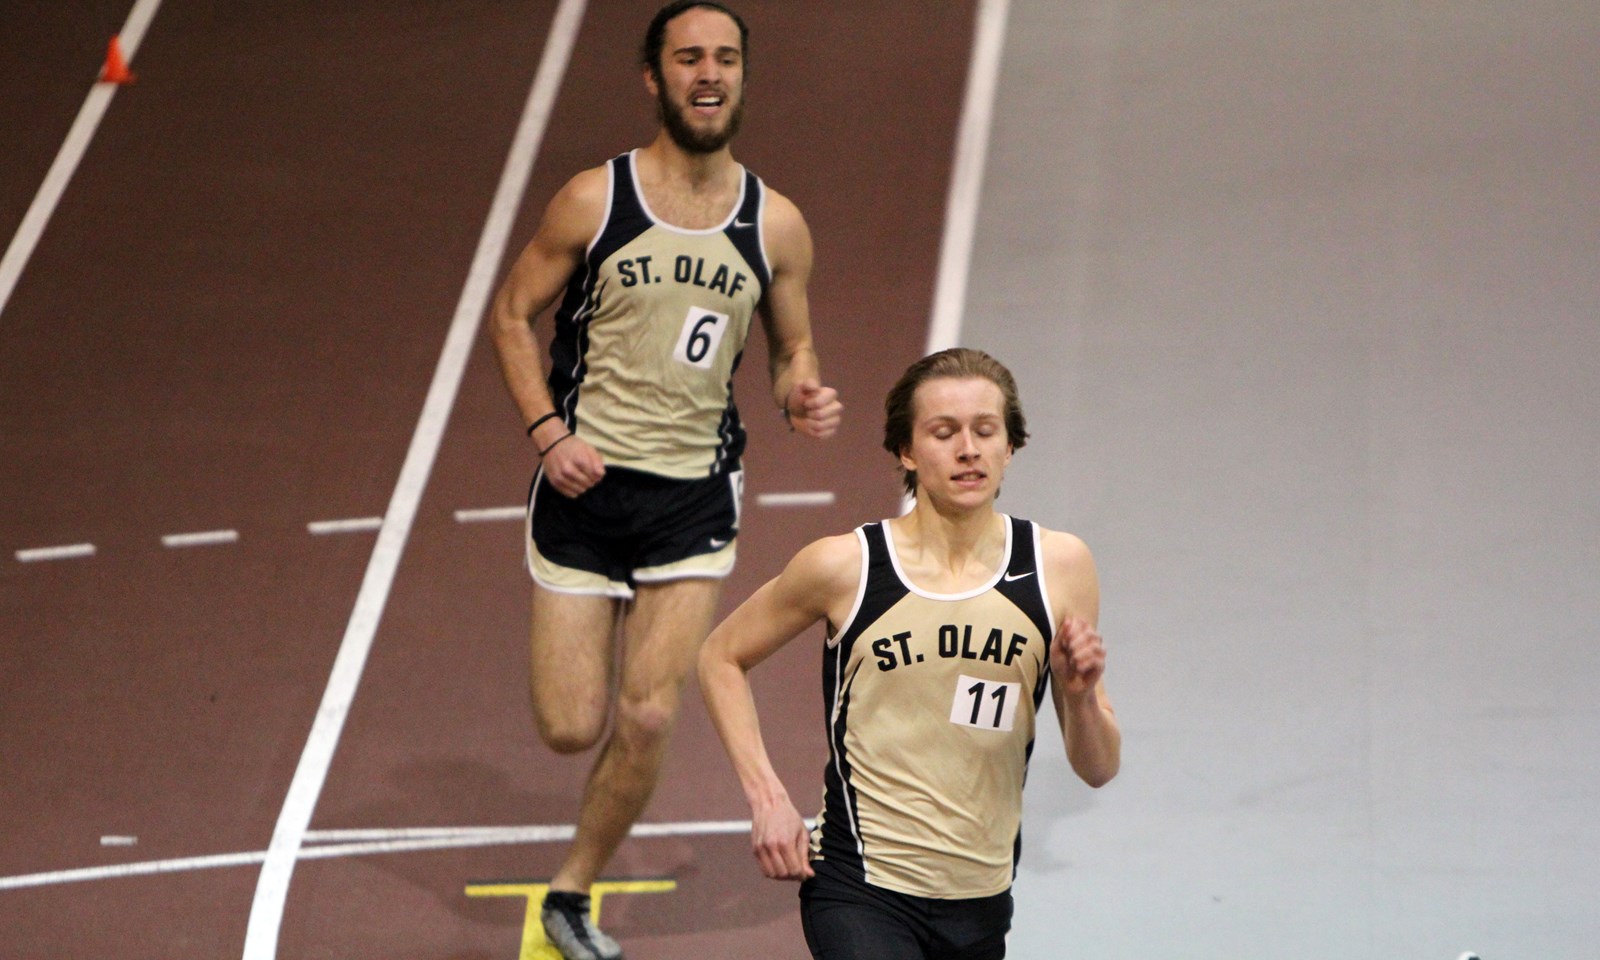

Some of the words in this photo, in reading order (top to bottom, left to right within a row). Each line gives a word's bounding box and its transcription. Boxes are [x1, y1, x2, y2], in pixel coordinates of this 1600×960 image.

[617, 255, 662, 287] ST.
[674, 254, 747, 298] OLAF
[686, 314, 718, 362] 6
[871, 631, 924, 672] ST.
[938, 624, 1028, 666] OLAF
[968, 681, 1008, 728] 11
